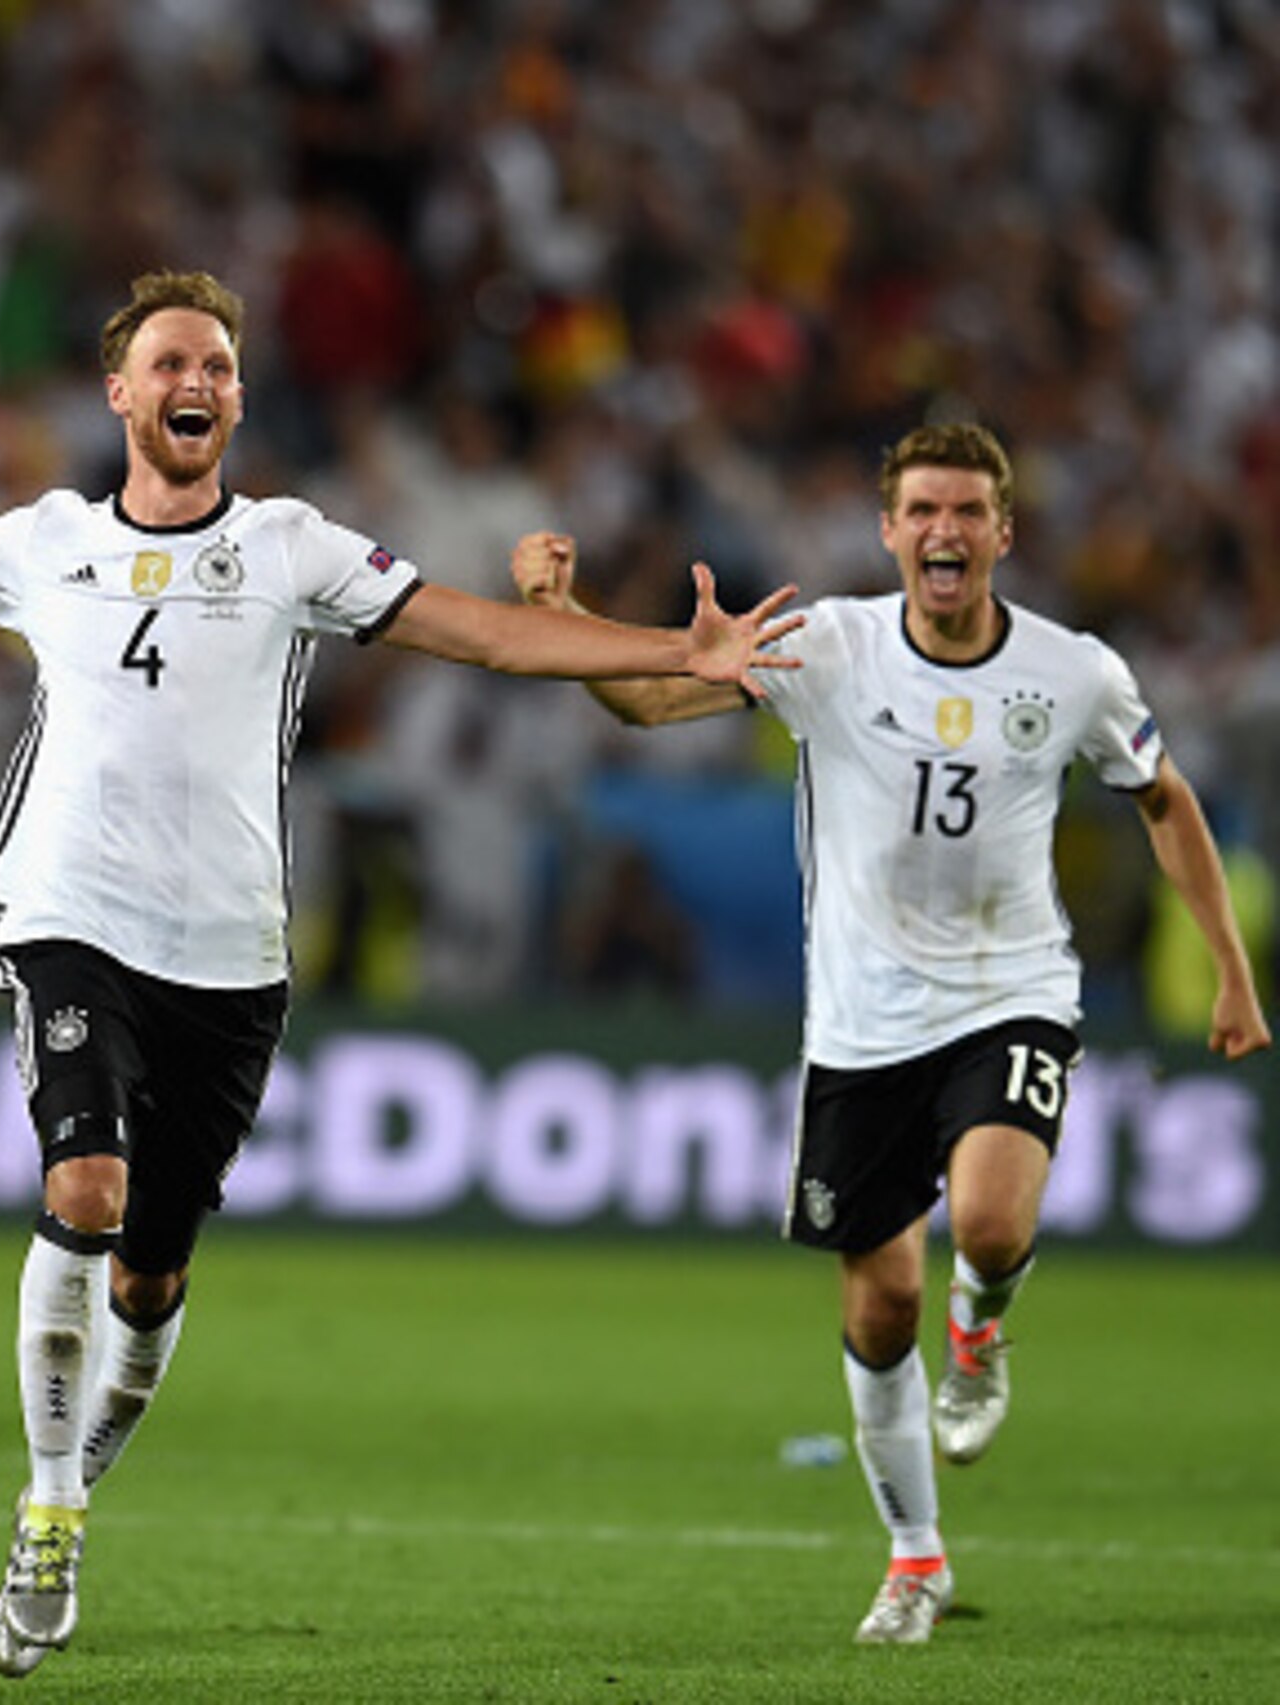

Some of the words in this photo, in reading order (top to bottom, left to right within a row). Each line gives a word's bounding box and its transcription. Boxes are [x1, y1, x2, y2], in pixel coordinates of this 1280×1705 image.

[120, 607, 166, 688] 4
[912, 759, 979, 838] 13
[1006, 1044, 1062, 1119] 13
